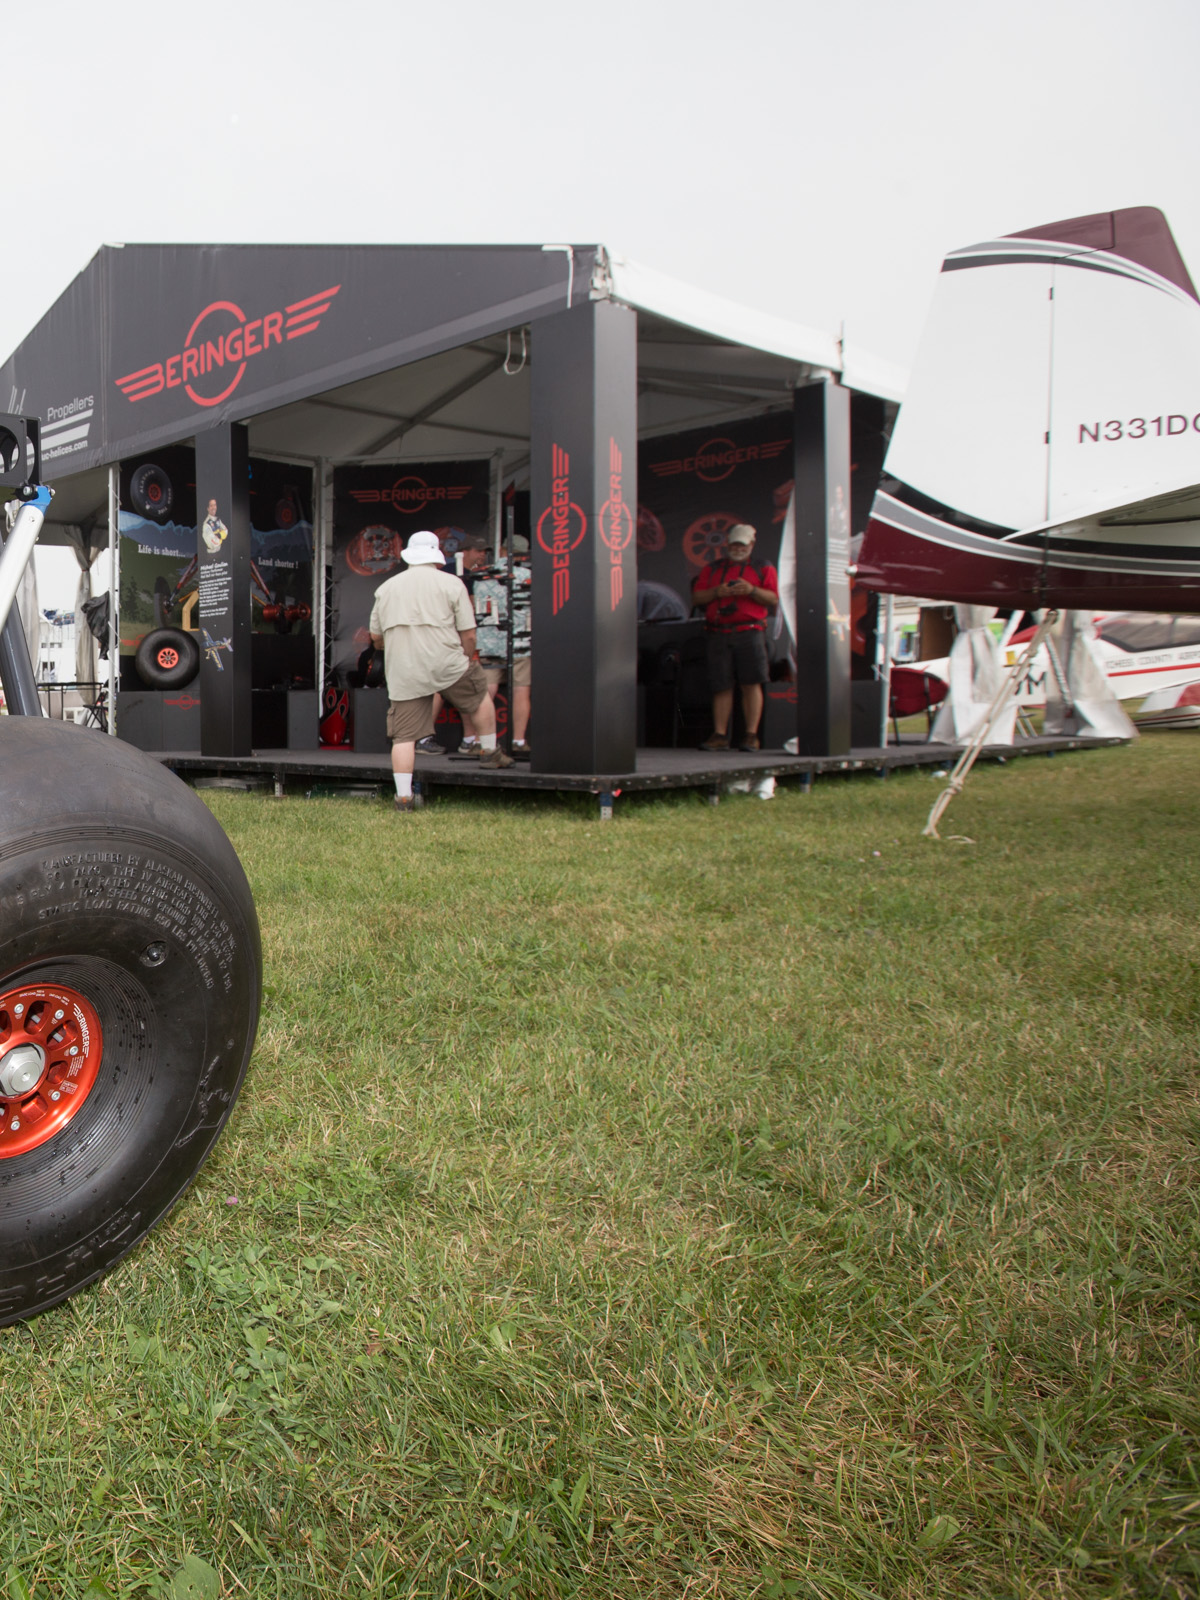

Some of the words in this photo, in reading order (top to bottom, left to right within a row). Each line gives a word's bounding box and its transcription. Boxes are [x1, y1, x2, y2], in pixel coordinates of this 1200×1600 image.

[114, 298, 310, 402] BERINGER
[47, 394, 94, 423] Propellers
[41, 440, 89, 462] uc-helices.com
[650, 443, 774, 476] BERINGER
[349, 485, 458, 503] BERINGER
[138, 544, 151, 554] Life
[154, 546, 160, 555] is
[552, 462, 570, 616] BERINGER
[610, 458, 624, 612] BERINGER
[258, 557, 273, 567] Land
[275, 559, 294, 569] shorter
[41, 853, 123, 873] MANUFACTURED
[127, 854, 140, 866] BY
[145, 859, 183, 884] ALASKAN
[100, 878, 130, 890] RATED
[171, 897, 191, 918] CORD
[155, 877, 194, 904] AIRCRAFT
[38, 901, 80, 919] STATIC
[85, 899, 113, 911] LOAD
[116, 900, 151, 918] RATING
[107, 888, 138, 901] SPEED
[157, 902, 188, 928] GROUND
[73, 1003, 89, 1053] BERINGER
